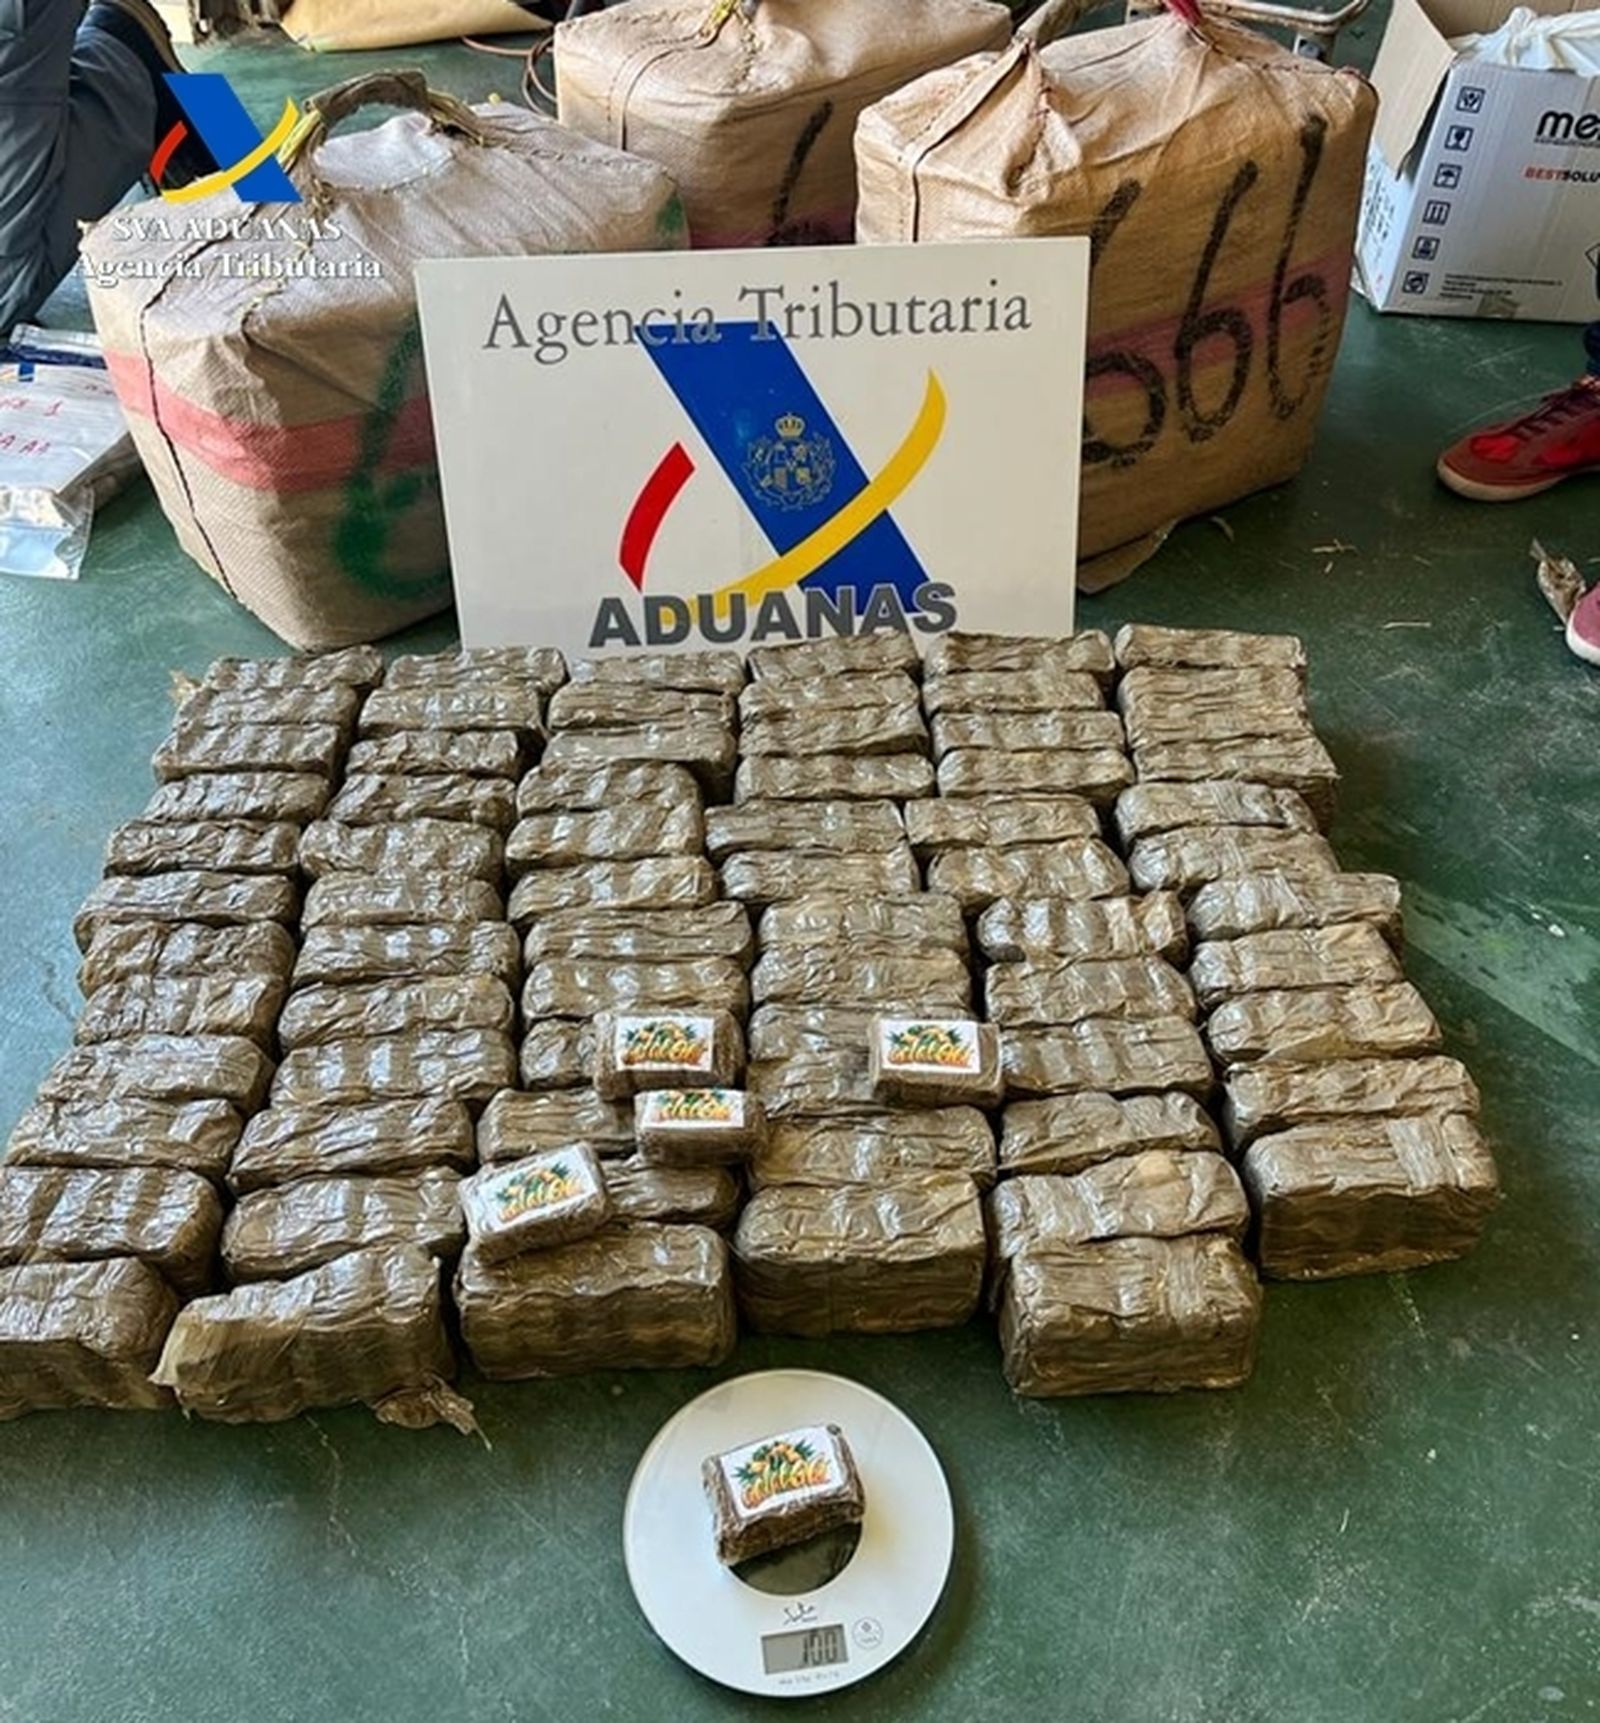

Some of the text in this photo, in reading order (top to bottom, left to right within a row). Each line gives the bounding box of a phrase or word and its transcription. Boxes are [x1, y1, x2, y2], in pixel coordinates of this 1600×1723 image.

[1536, 110, 1600, 140] me
[1525, 166, 1600, 183] BESTSOLU
[482, 279, 1033, 365] Agencia Tributaria
[588, 582, 958, 648] ADUANAS
[802, 1629, 838, 1666] 100
